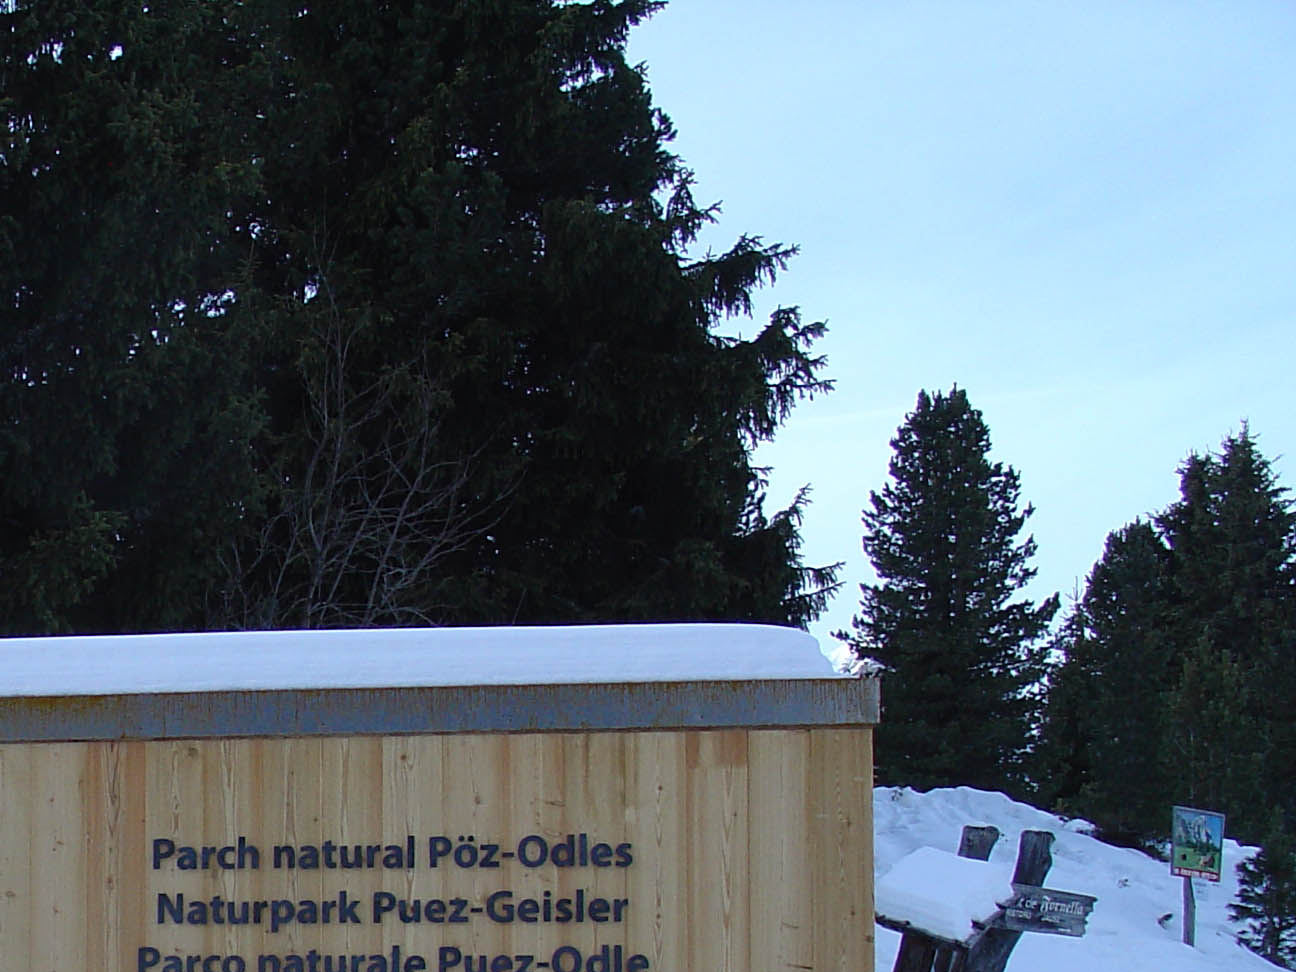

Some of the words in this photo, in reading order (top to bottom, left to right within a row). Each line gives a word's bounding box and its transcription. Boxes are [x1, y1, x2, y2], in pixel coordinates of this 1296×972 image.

[152, 836, 260, 870] Parch
[273, 835, 415, 870] natural
[428, 833, 635, 869] Pöz-Odles
[156, 889, 361, 934] Naturpark
[372, 889, 630, 925] Puez-Geisler
